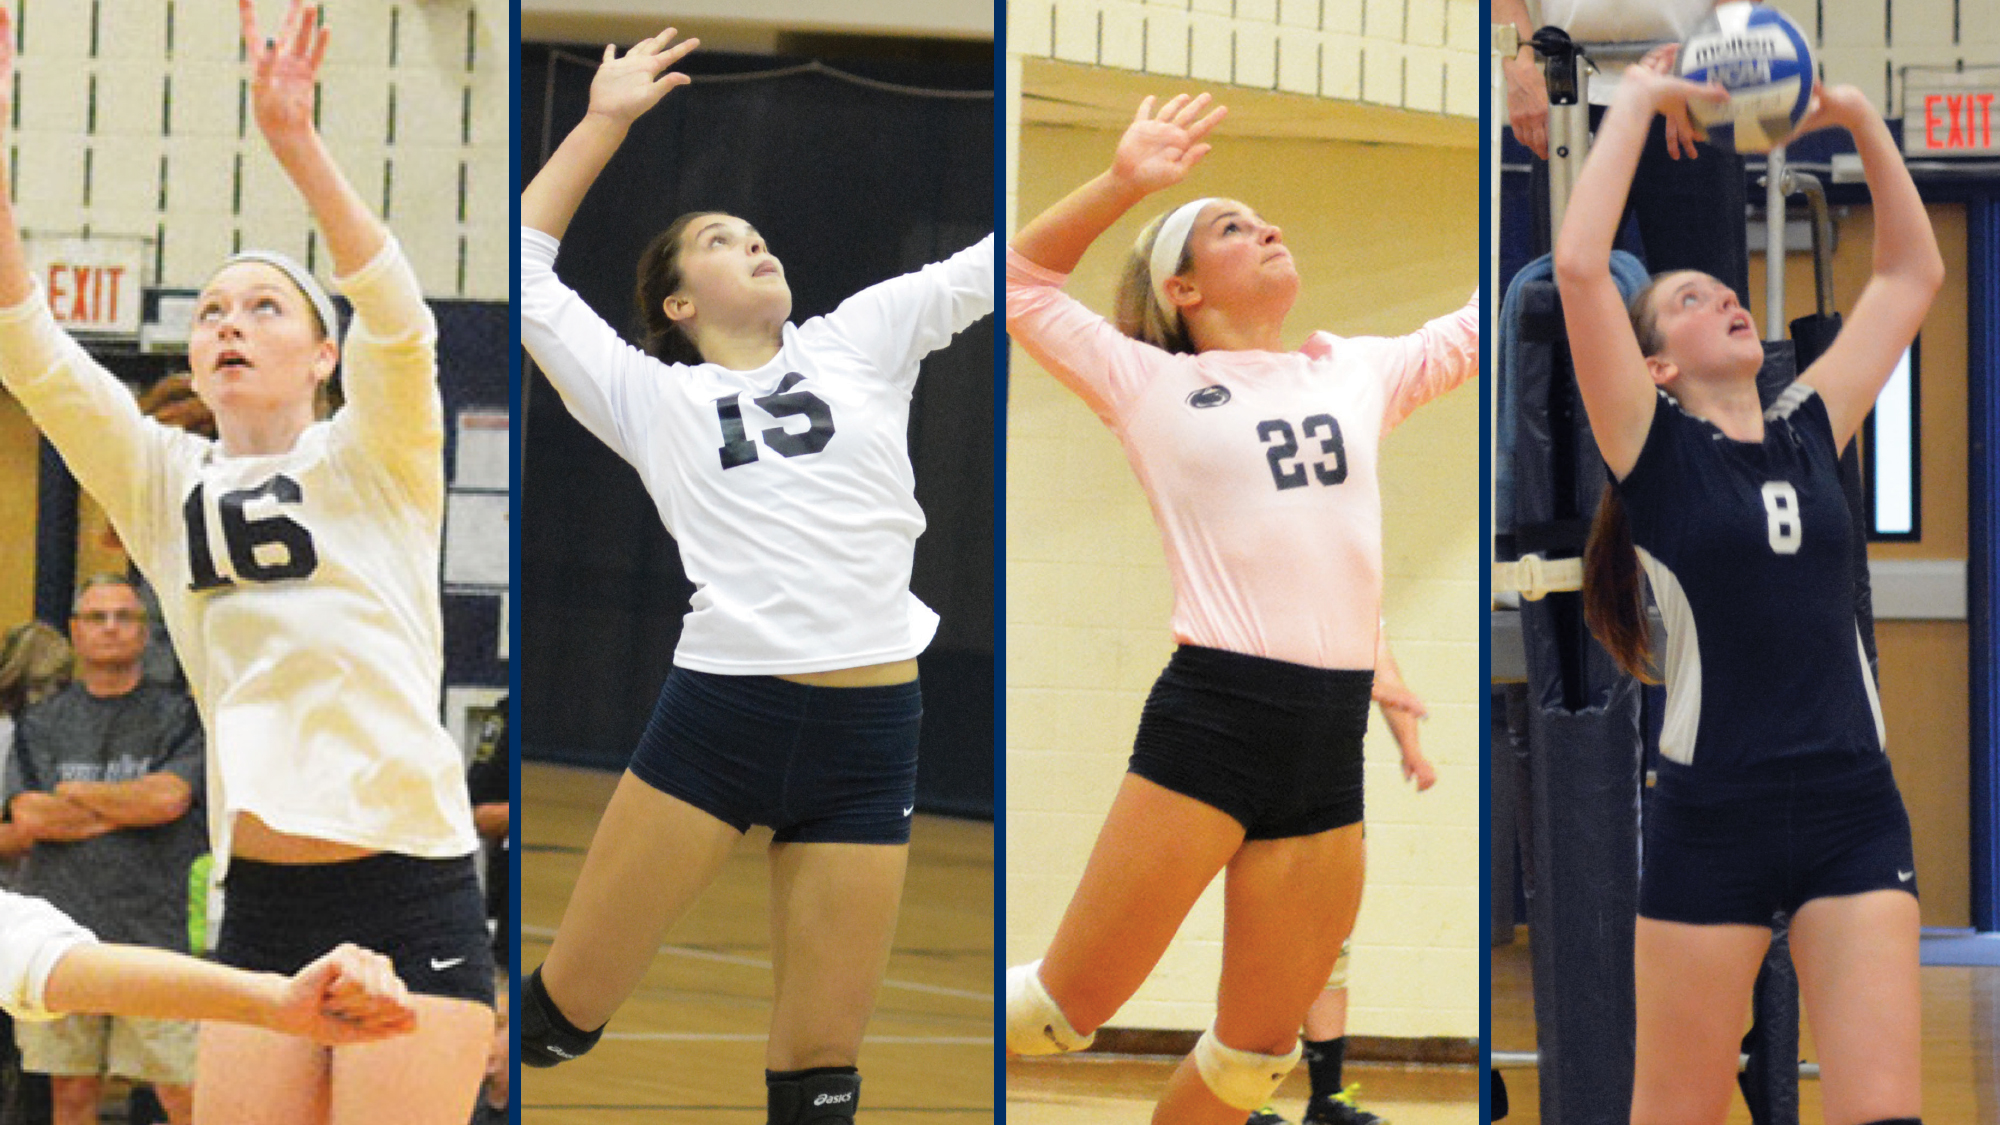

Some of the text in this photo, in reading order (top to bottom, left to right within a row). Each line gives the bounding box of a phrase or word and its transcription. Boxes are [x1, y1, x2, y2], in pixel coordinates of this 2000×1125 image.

[1696, 37, 1776, 64] molten
[1925, 93, 1995, 149] EXIT
[48, 263, 125, 323] EXIT
[714, 372, 836, 470] 15
[1256, 413, 1348, 491] 23
[183, 473, 317, 591] 16
[1761, 480, 1802, 554] 8
[814, 1092, 852, 1106] asics
